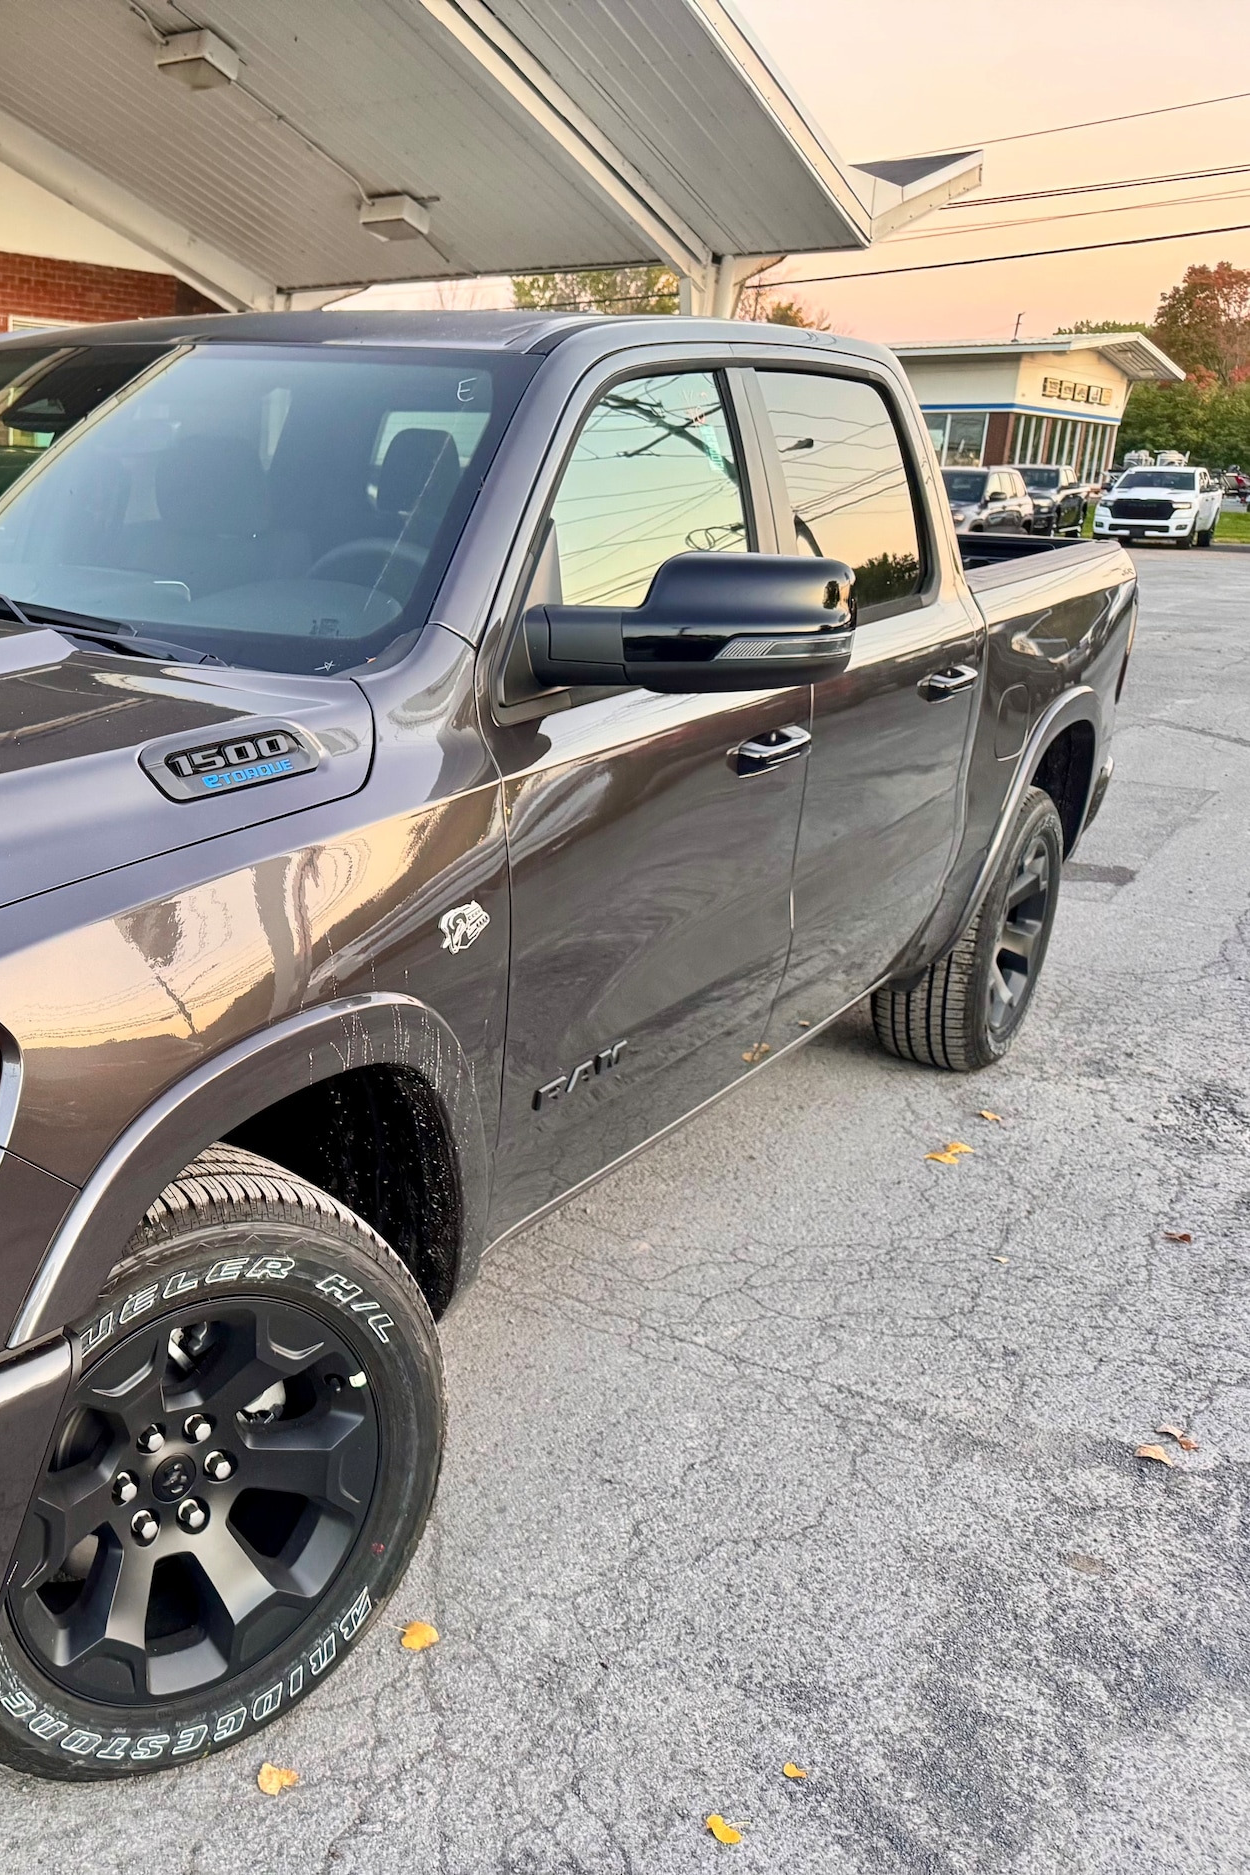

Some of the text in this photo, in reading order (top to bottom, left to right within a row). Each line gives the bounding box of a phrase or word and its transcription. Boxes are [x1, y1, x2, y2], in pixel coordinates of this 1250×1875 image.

[169, 733, 291, 778] 1500
[202, 758, 295, 789] eTORQUE
[531, 1039, 629, 1112] RAM
[80, 1255, 296, 1358] UELER
[0, 1584, 373, 1761] BRIDGESTONE
